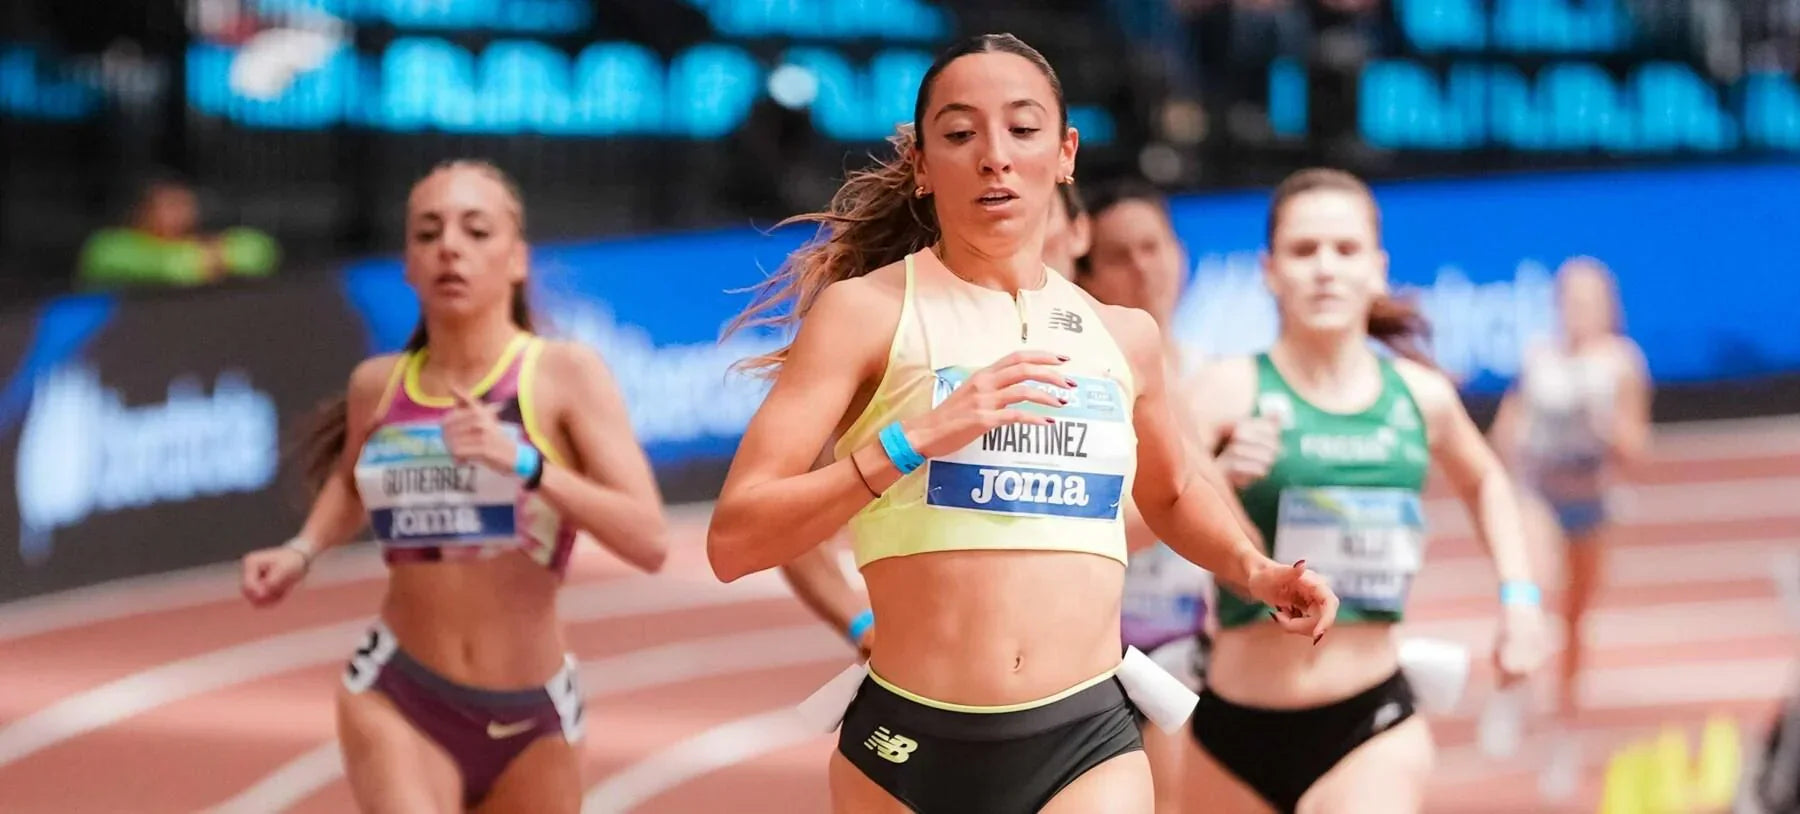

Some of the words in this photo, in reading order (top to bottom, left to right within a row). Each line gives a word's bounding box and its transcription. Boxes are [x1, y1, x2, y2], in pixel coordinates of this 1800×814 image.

[982, 421, 1088, 458] MARTINEZ
[383, 465, 477, 496] GUTIERREZ
[863, 725, 919, 764] NB
